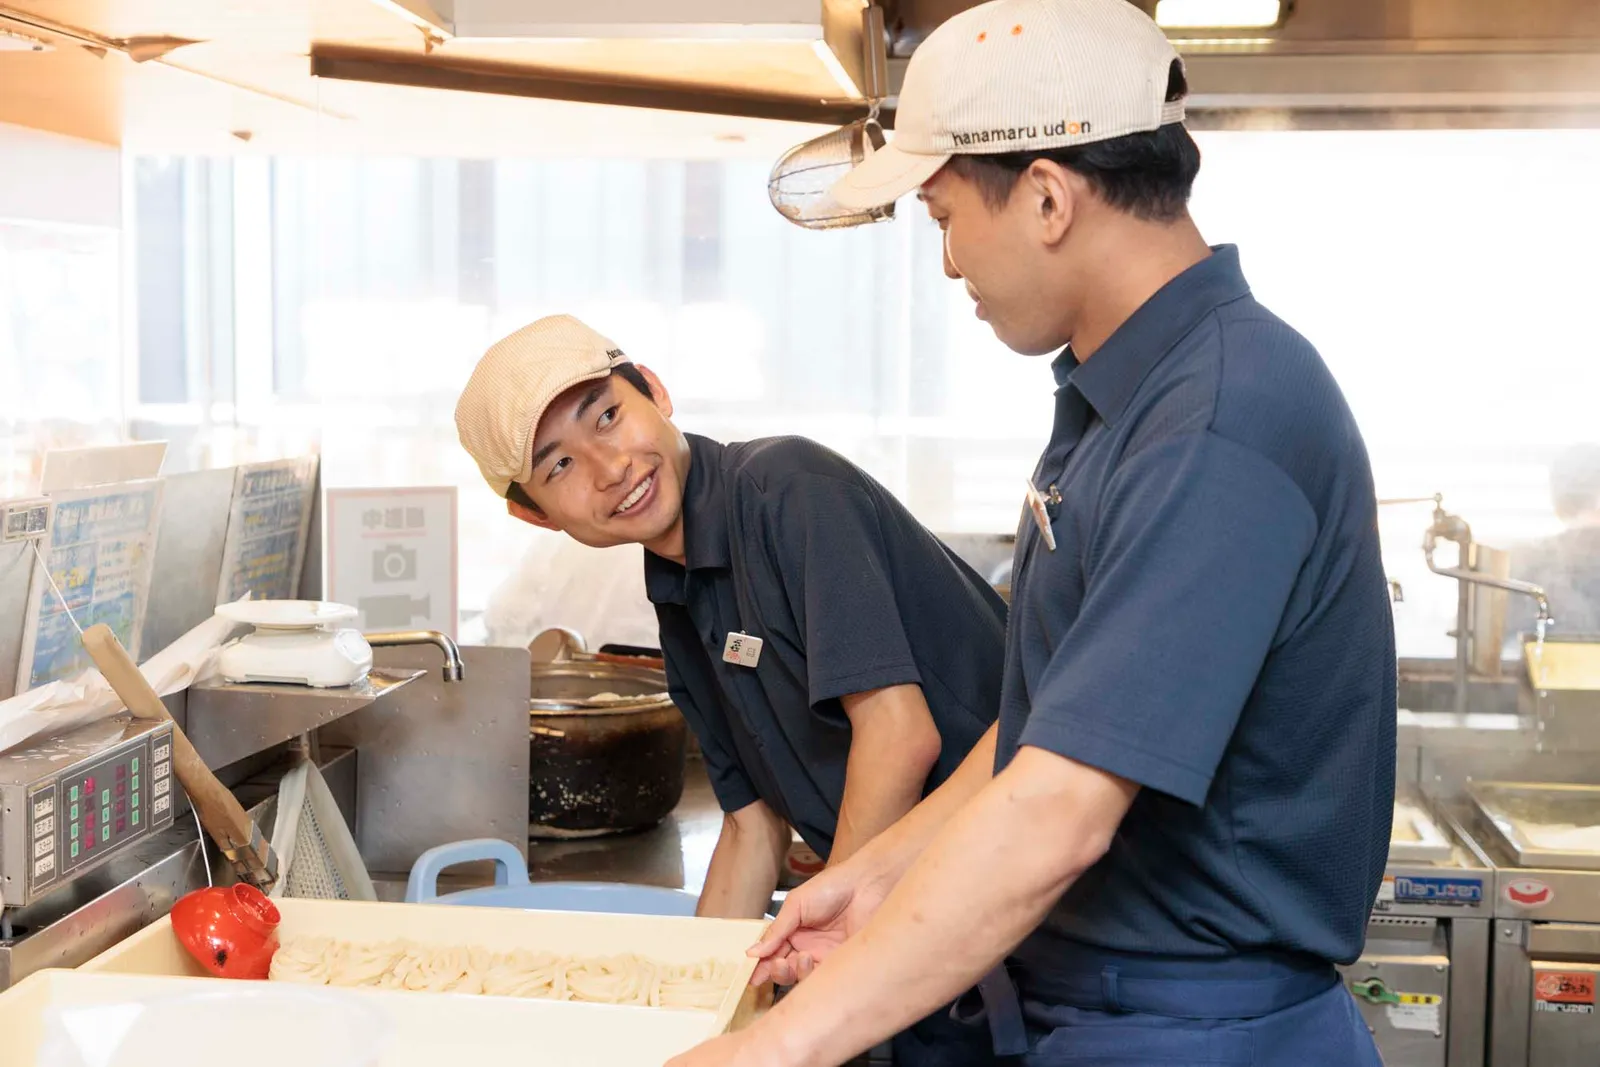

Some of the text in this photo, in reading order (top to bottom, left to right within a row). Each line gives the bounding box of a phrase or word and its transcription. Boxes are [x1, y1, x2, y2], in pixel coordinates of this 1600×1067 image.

[952, 120, 1091, 146] hanamaru udon
[1396, 878, 1481, 898] Maruzen
[1535, 999, 1594, 1014] Maruzen
